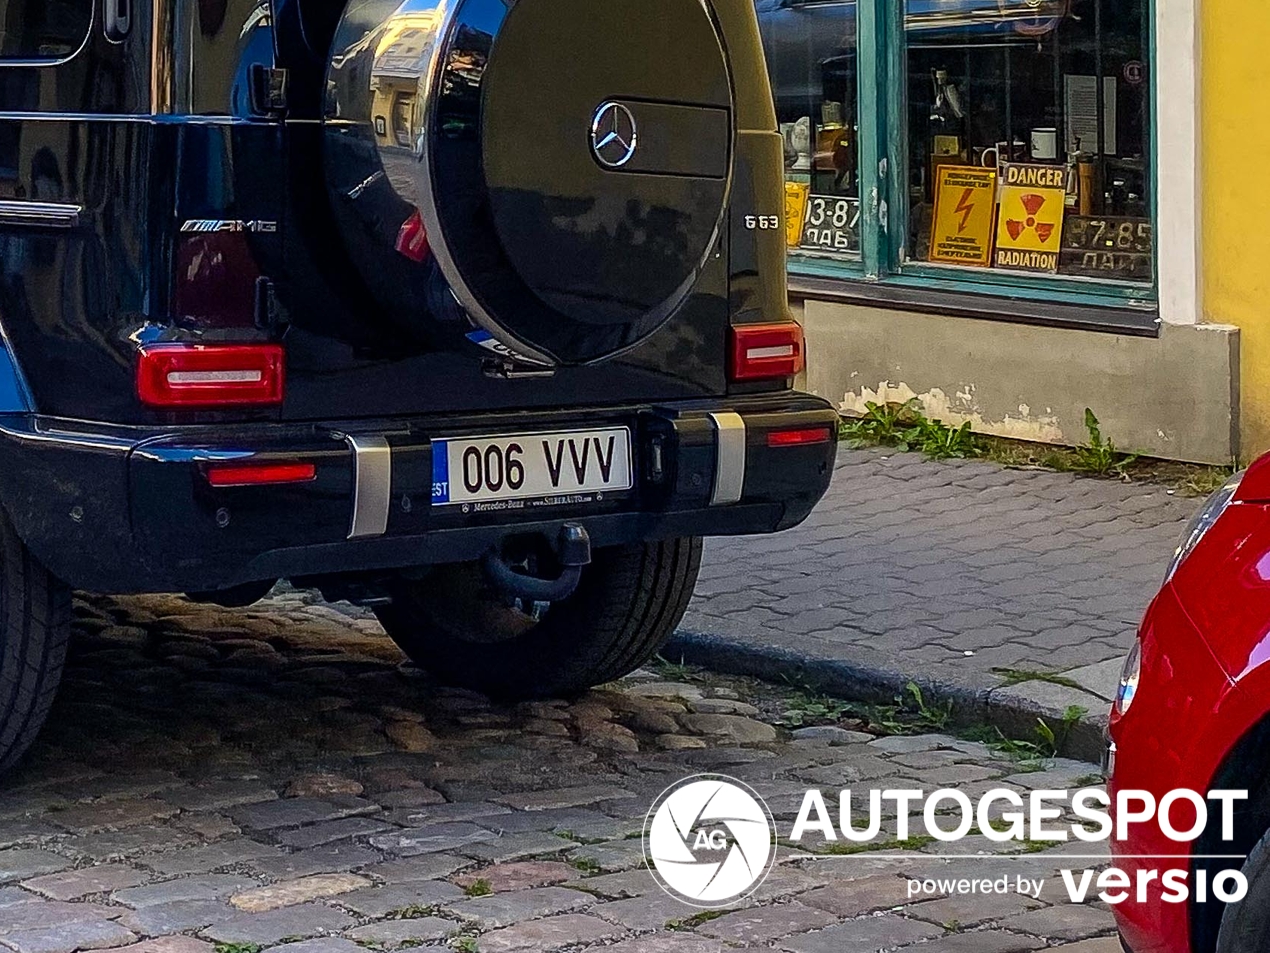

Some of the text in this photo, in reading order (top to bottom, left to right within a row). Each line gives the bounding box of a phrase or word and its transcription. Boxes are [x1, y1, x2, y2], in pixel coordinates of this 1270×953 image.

[1007, 167, 1063, 186] DANGER
[997, 250, 1057, 268] RADIATION
[462, 436, 615, 494] 006 VVV
